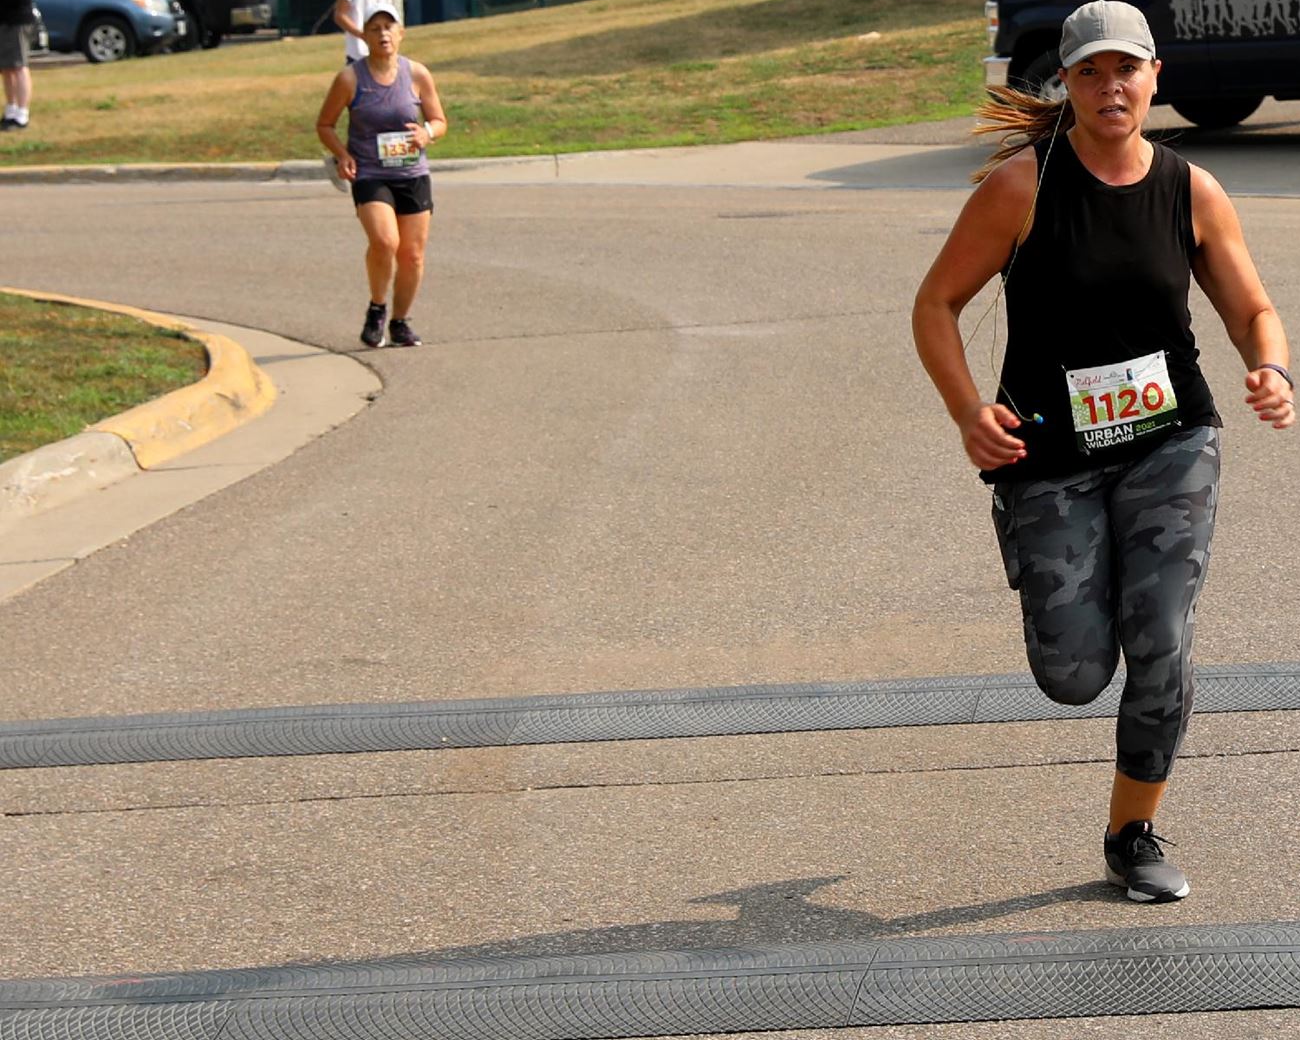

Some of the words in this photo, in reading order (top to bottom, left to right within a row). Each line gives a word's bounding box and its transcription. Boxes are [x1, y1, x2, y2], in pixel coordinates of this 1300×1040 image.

[1082, 382, 1165, 425] 1120
[1084, 424, 1134, 442] URBAN
[1135, 421, 1156, 432] 2021
[1086, 433, 1135, 449] WILDLAND
